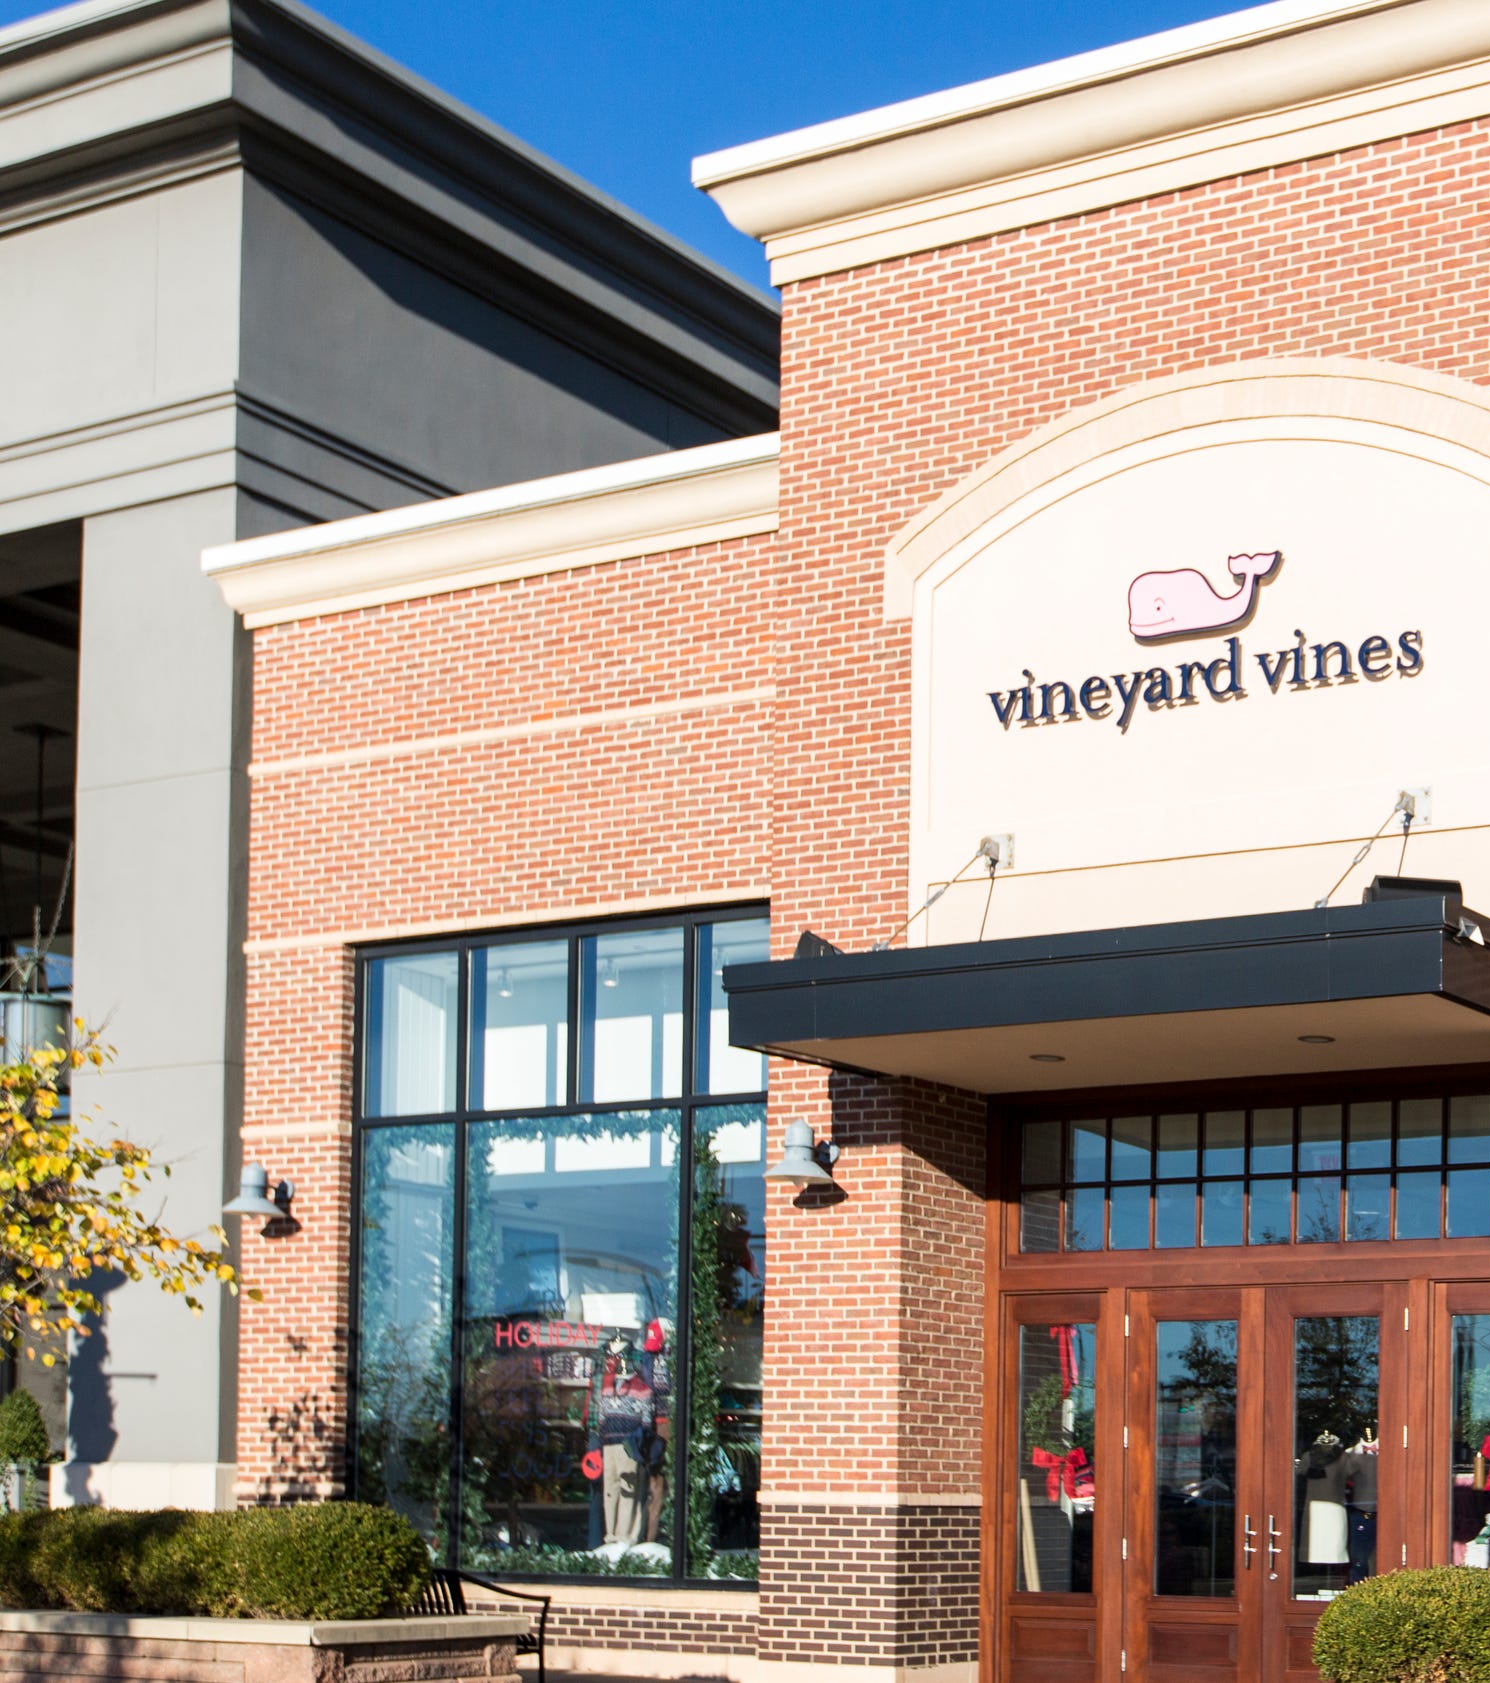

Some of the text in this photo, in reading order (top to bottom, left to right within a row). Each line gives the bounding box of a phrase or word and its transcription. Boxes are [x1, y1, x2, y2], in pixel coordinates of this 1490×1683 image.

[986, 628, 1424, 733] vineyard vines
[495, 1320, 602, 1349] HOLIDAY
